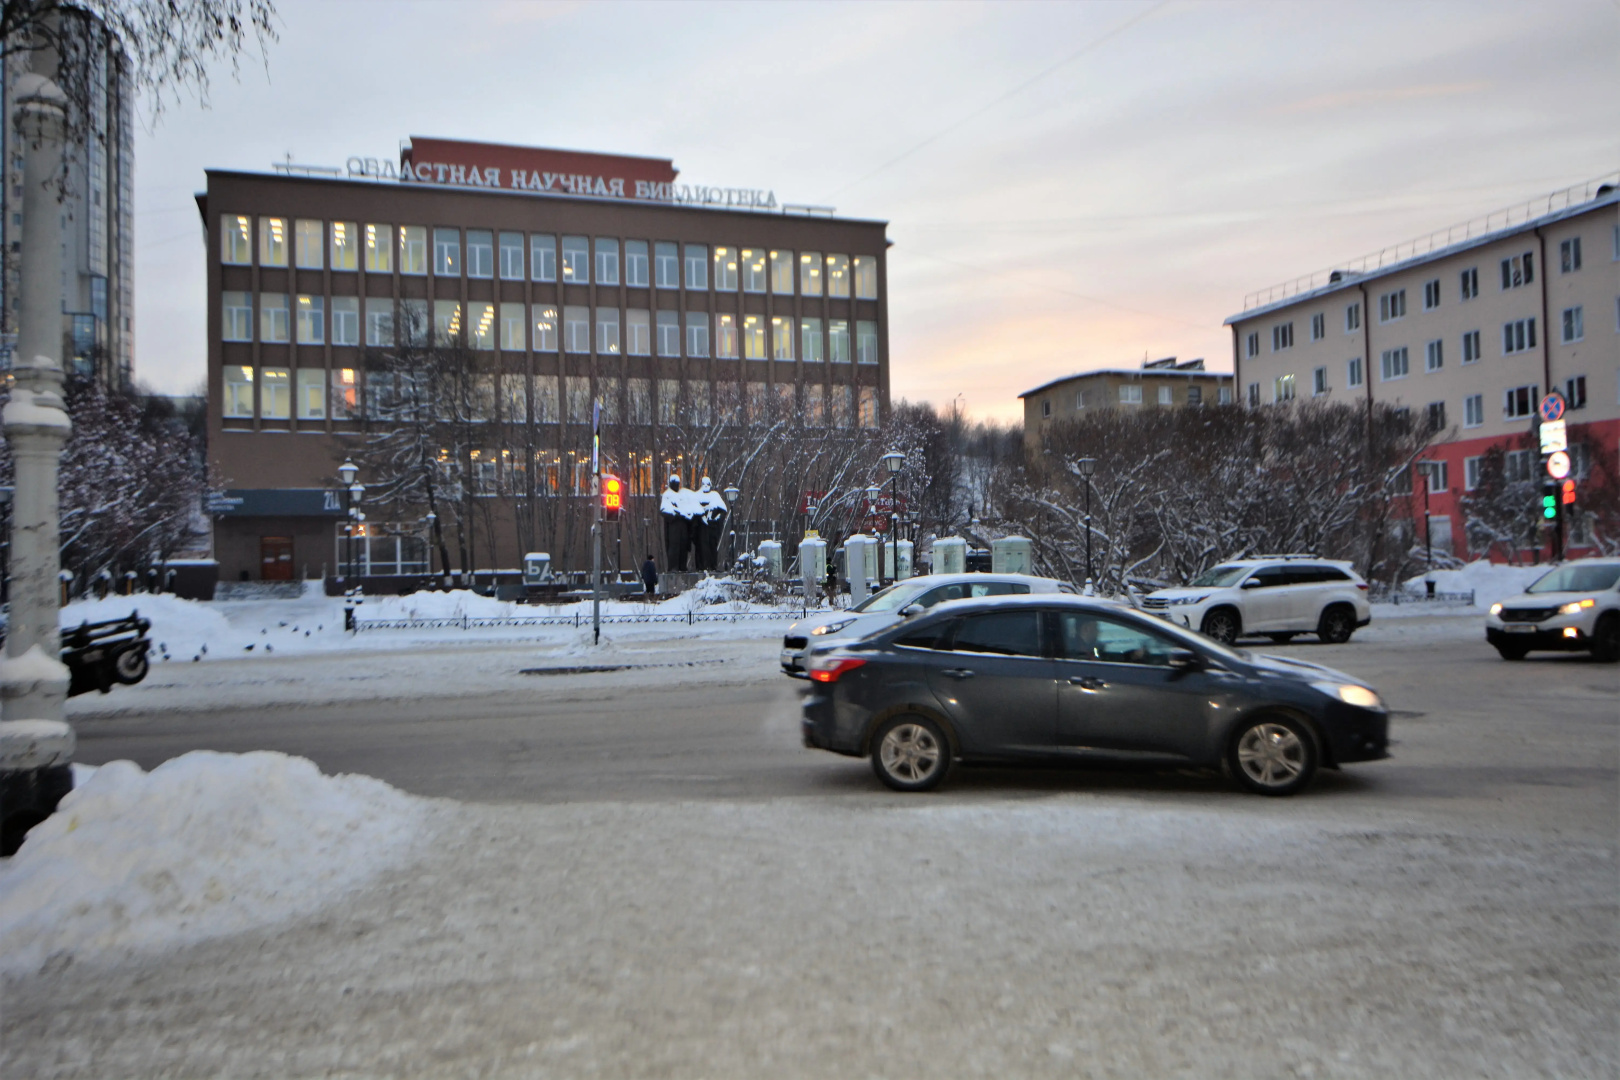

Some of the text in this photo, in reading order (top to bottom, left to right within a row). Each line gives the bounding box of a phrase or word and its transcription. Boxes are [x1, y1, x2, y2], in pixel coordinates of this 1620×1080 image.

[346, 156, 778, 207] ОБЛАСТНАЯ НАУЧНАЯ БИБЛИОТЕКА
[606, 494, 620, 507] 08
